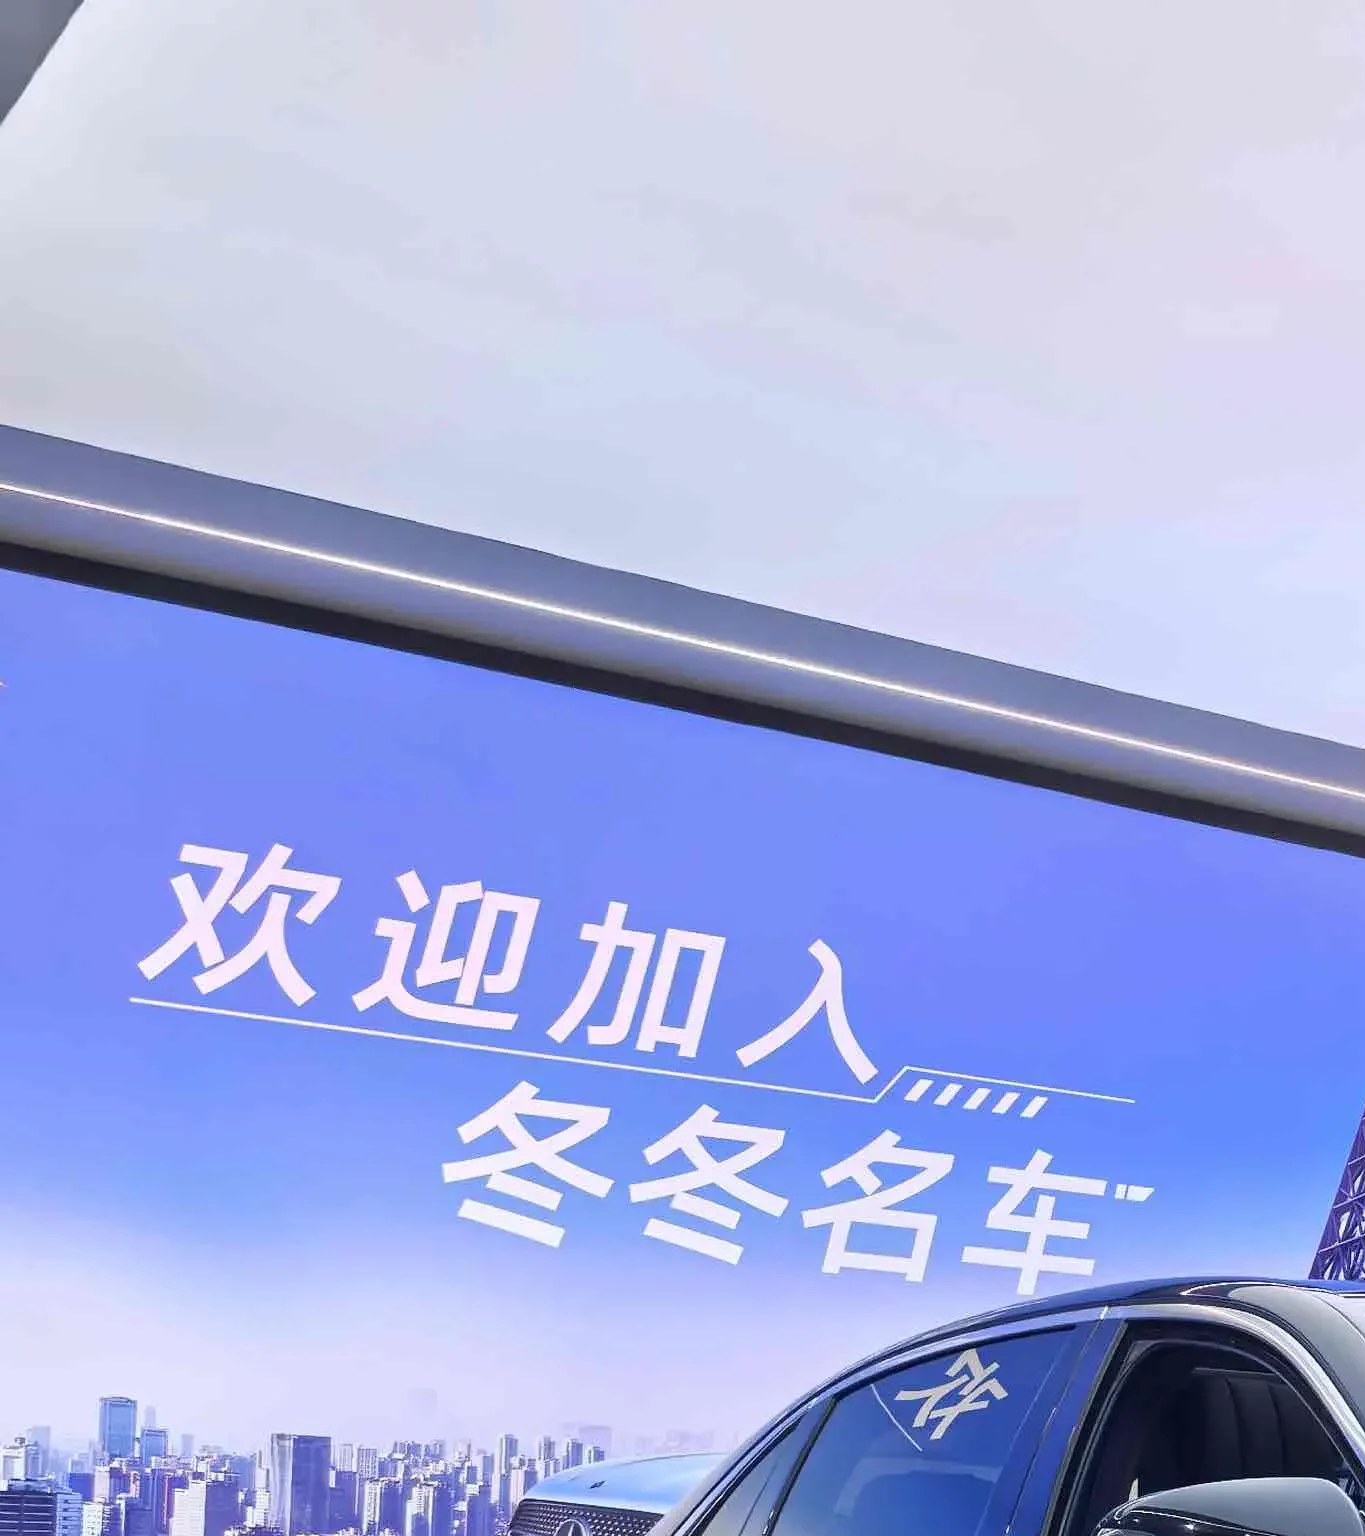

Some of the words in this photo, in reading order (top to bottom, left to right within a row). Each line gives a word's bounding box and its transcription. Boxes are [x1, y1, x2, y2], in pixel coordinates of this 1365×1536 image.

[138, 844, 878, 1084] 欢迎加入
[442, 1081, 1106, 1297] 冬冬名车
